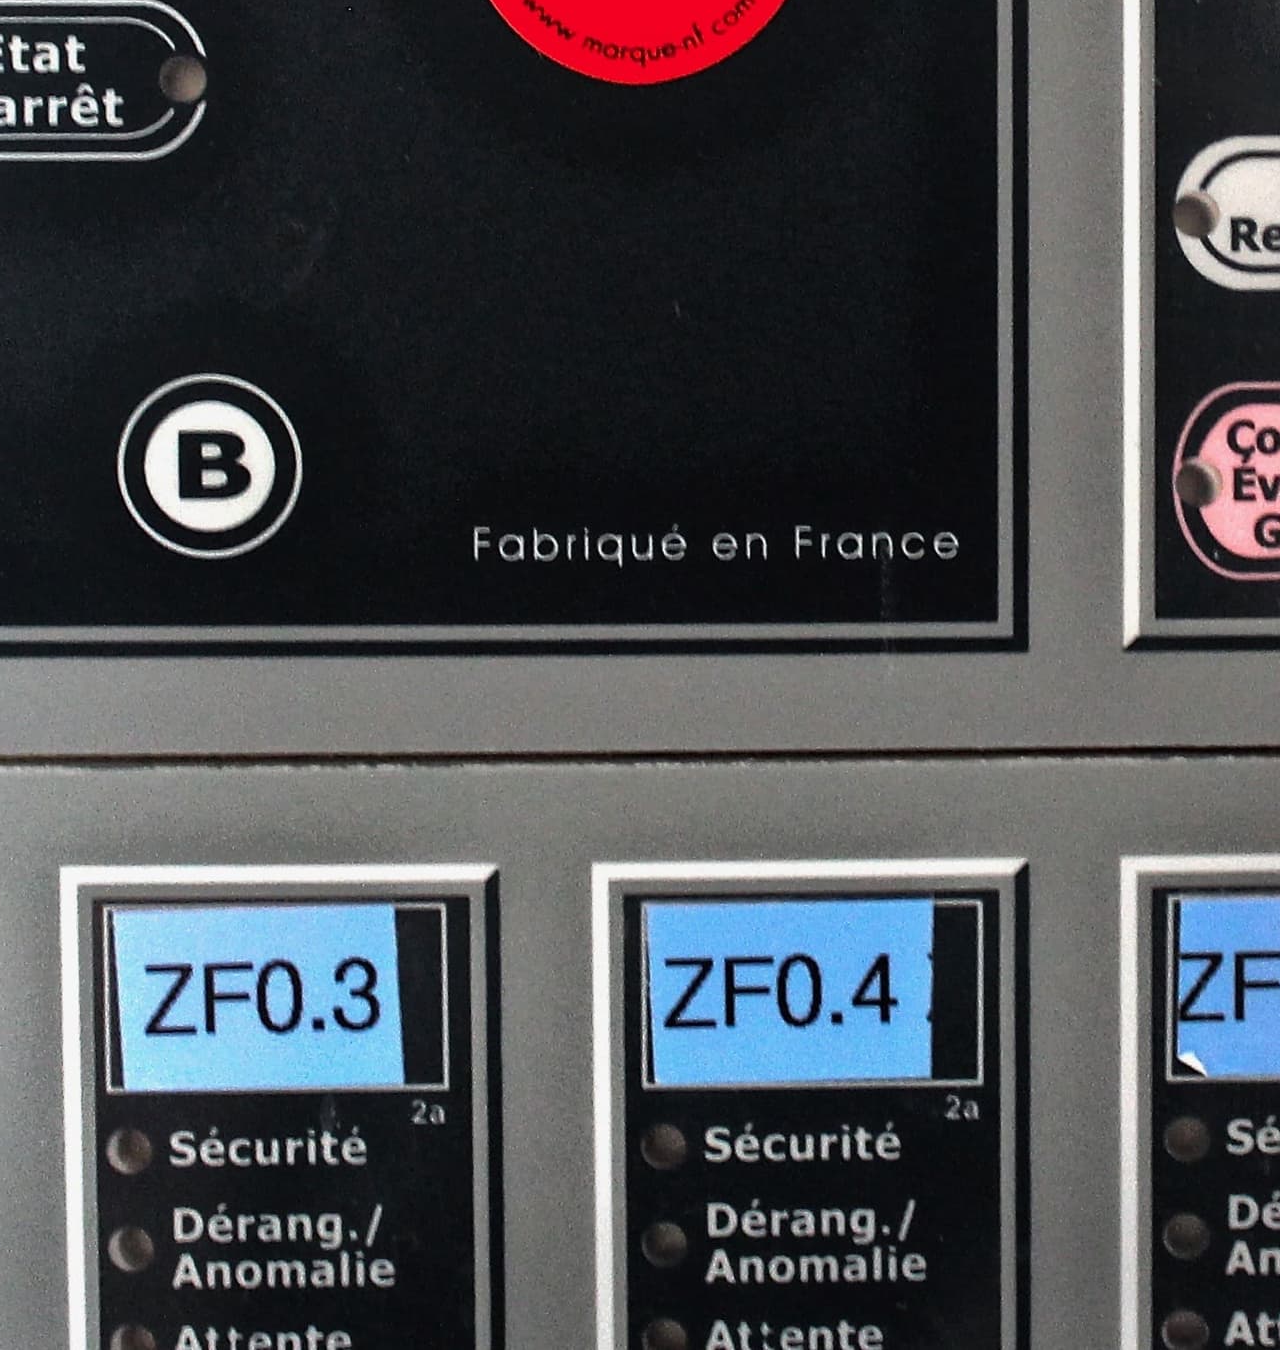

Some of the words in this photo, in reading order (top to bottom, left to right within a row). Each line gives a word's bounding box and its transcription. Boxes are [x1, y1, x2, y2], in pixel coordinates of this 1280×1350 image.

[179, 431, 251, 499] B
[474, 525, 687, 567] Fabriqué
[712, 533, 767, 560] en
[795, 526, 959, 559] France
[145, 957, 380, 1035] ZF0.3
[664, 954, 898, 1028] ZF0.4
[412, 1100, 445, 1124] 2a
[945, 1095, 979, 1119] 2a
[170, 1127, 366, 1166] Sécurité
[705, 1123, 900, 1161] Sécurité
[173, 1251, 394, 1288] Anomalie
[706, 1246, 926, 1283] Anomalie
